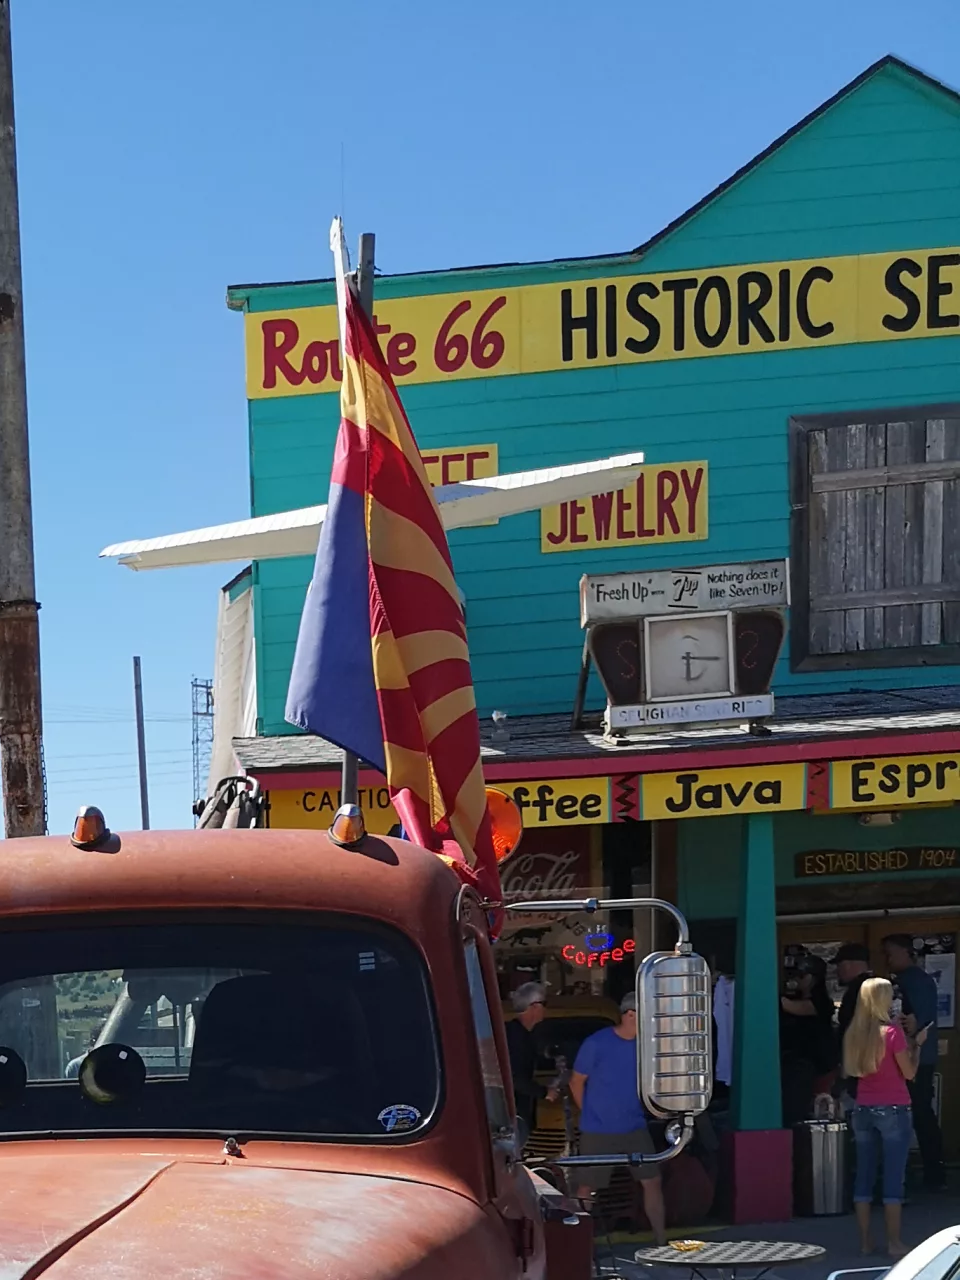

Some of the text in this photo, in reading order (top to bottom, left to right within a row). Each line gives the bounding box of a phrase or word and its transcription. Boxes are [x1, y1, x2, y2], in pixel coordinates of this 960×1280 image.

[434, 296, 507, 373] 66
[561, 265, 834, 362] HISTORIC
[882, 254, 960, 332] SE
[547, 467, 704, 545] JEWELRY
[707, 567, 779, 584] Nothing does it
[709, 587, 726, 599] like
[665, 774, 782, 813] Java
[804, 849, 956, 873] ESTABLISHED 1904
